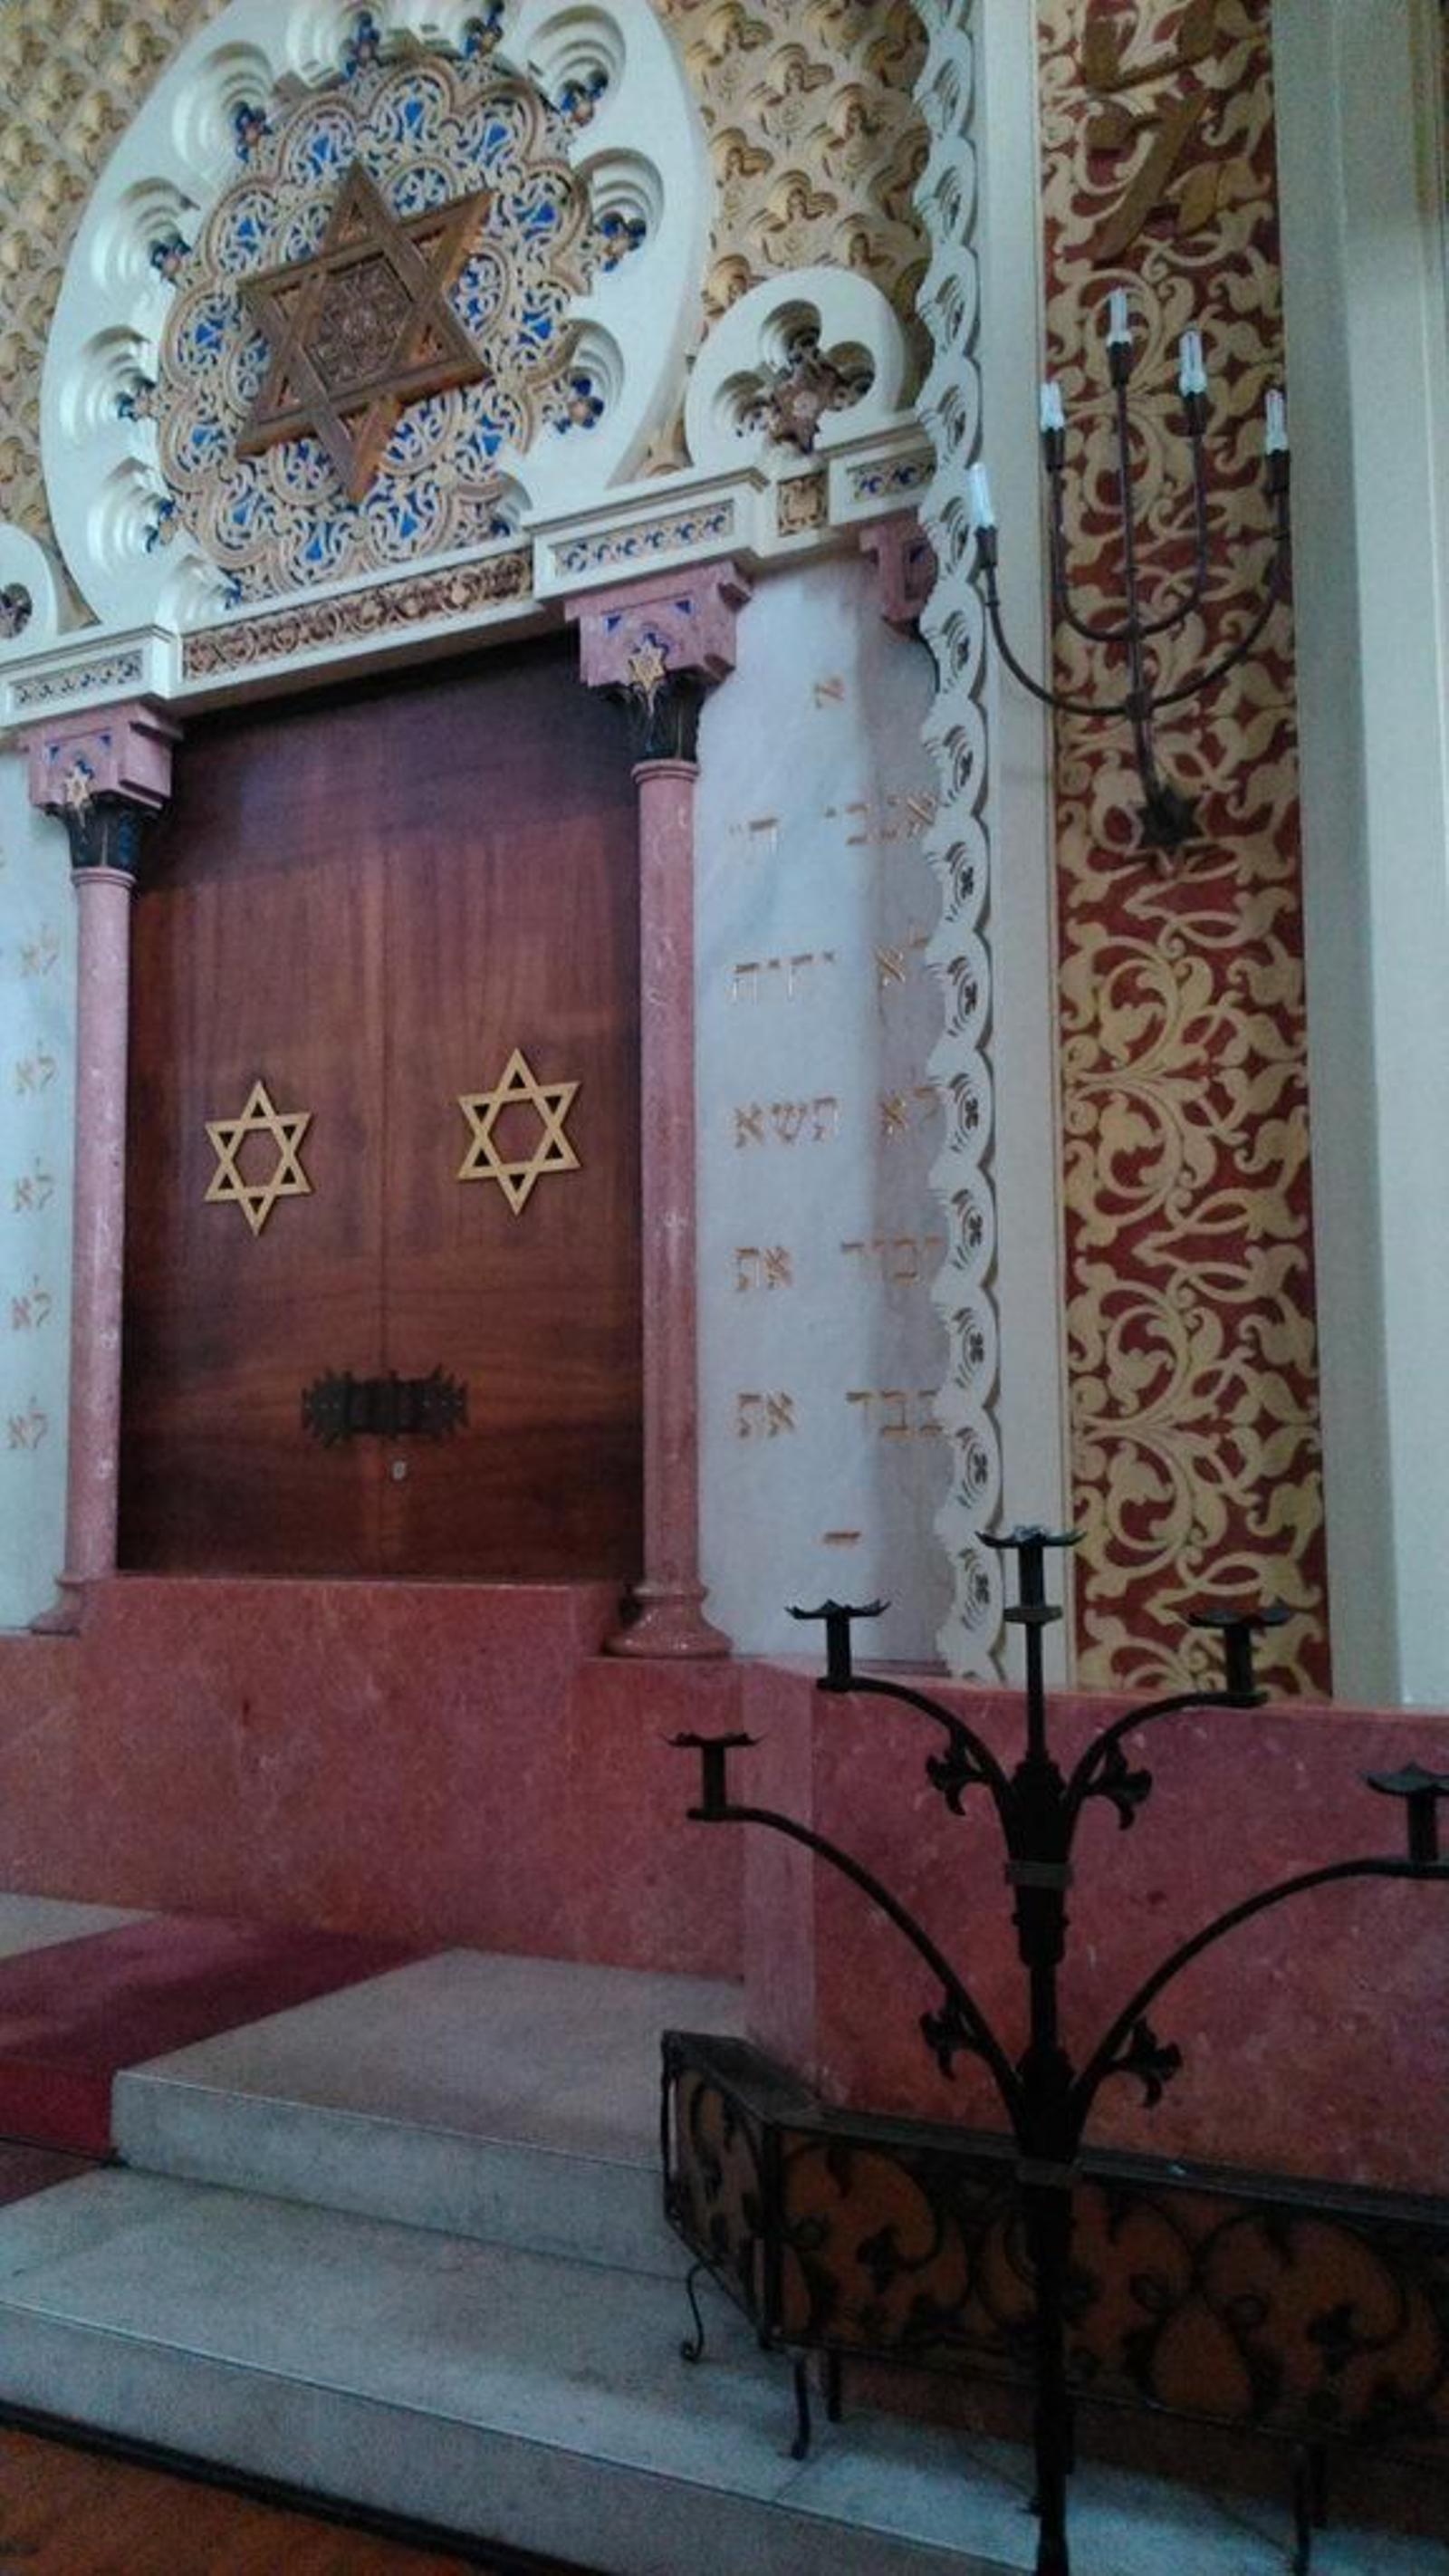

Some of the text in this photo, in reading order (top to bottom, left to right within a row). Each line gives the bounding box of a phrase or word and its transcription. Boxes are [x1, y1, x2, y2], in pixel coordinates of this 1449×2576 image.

[734, 1096, 839, 1149] תשא
[735, 1245, 792, 1290] את
[736, 1390, 795, 1439] את
